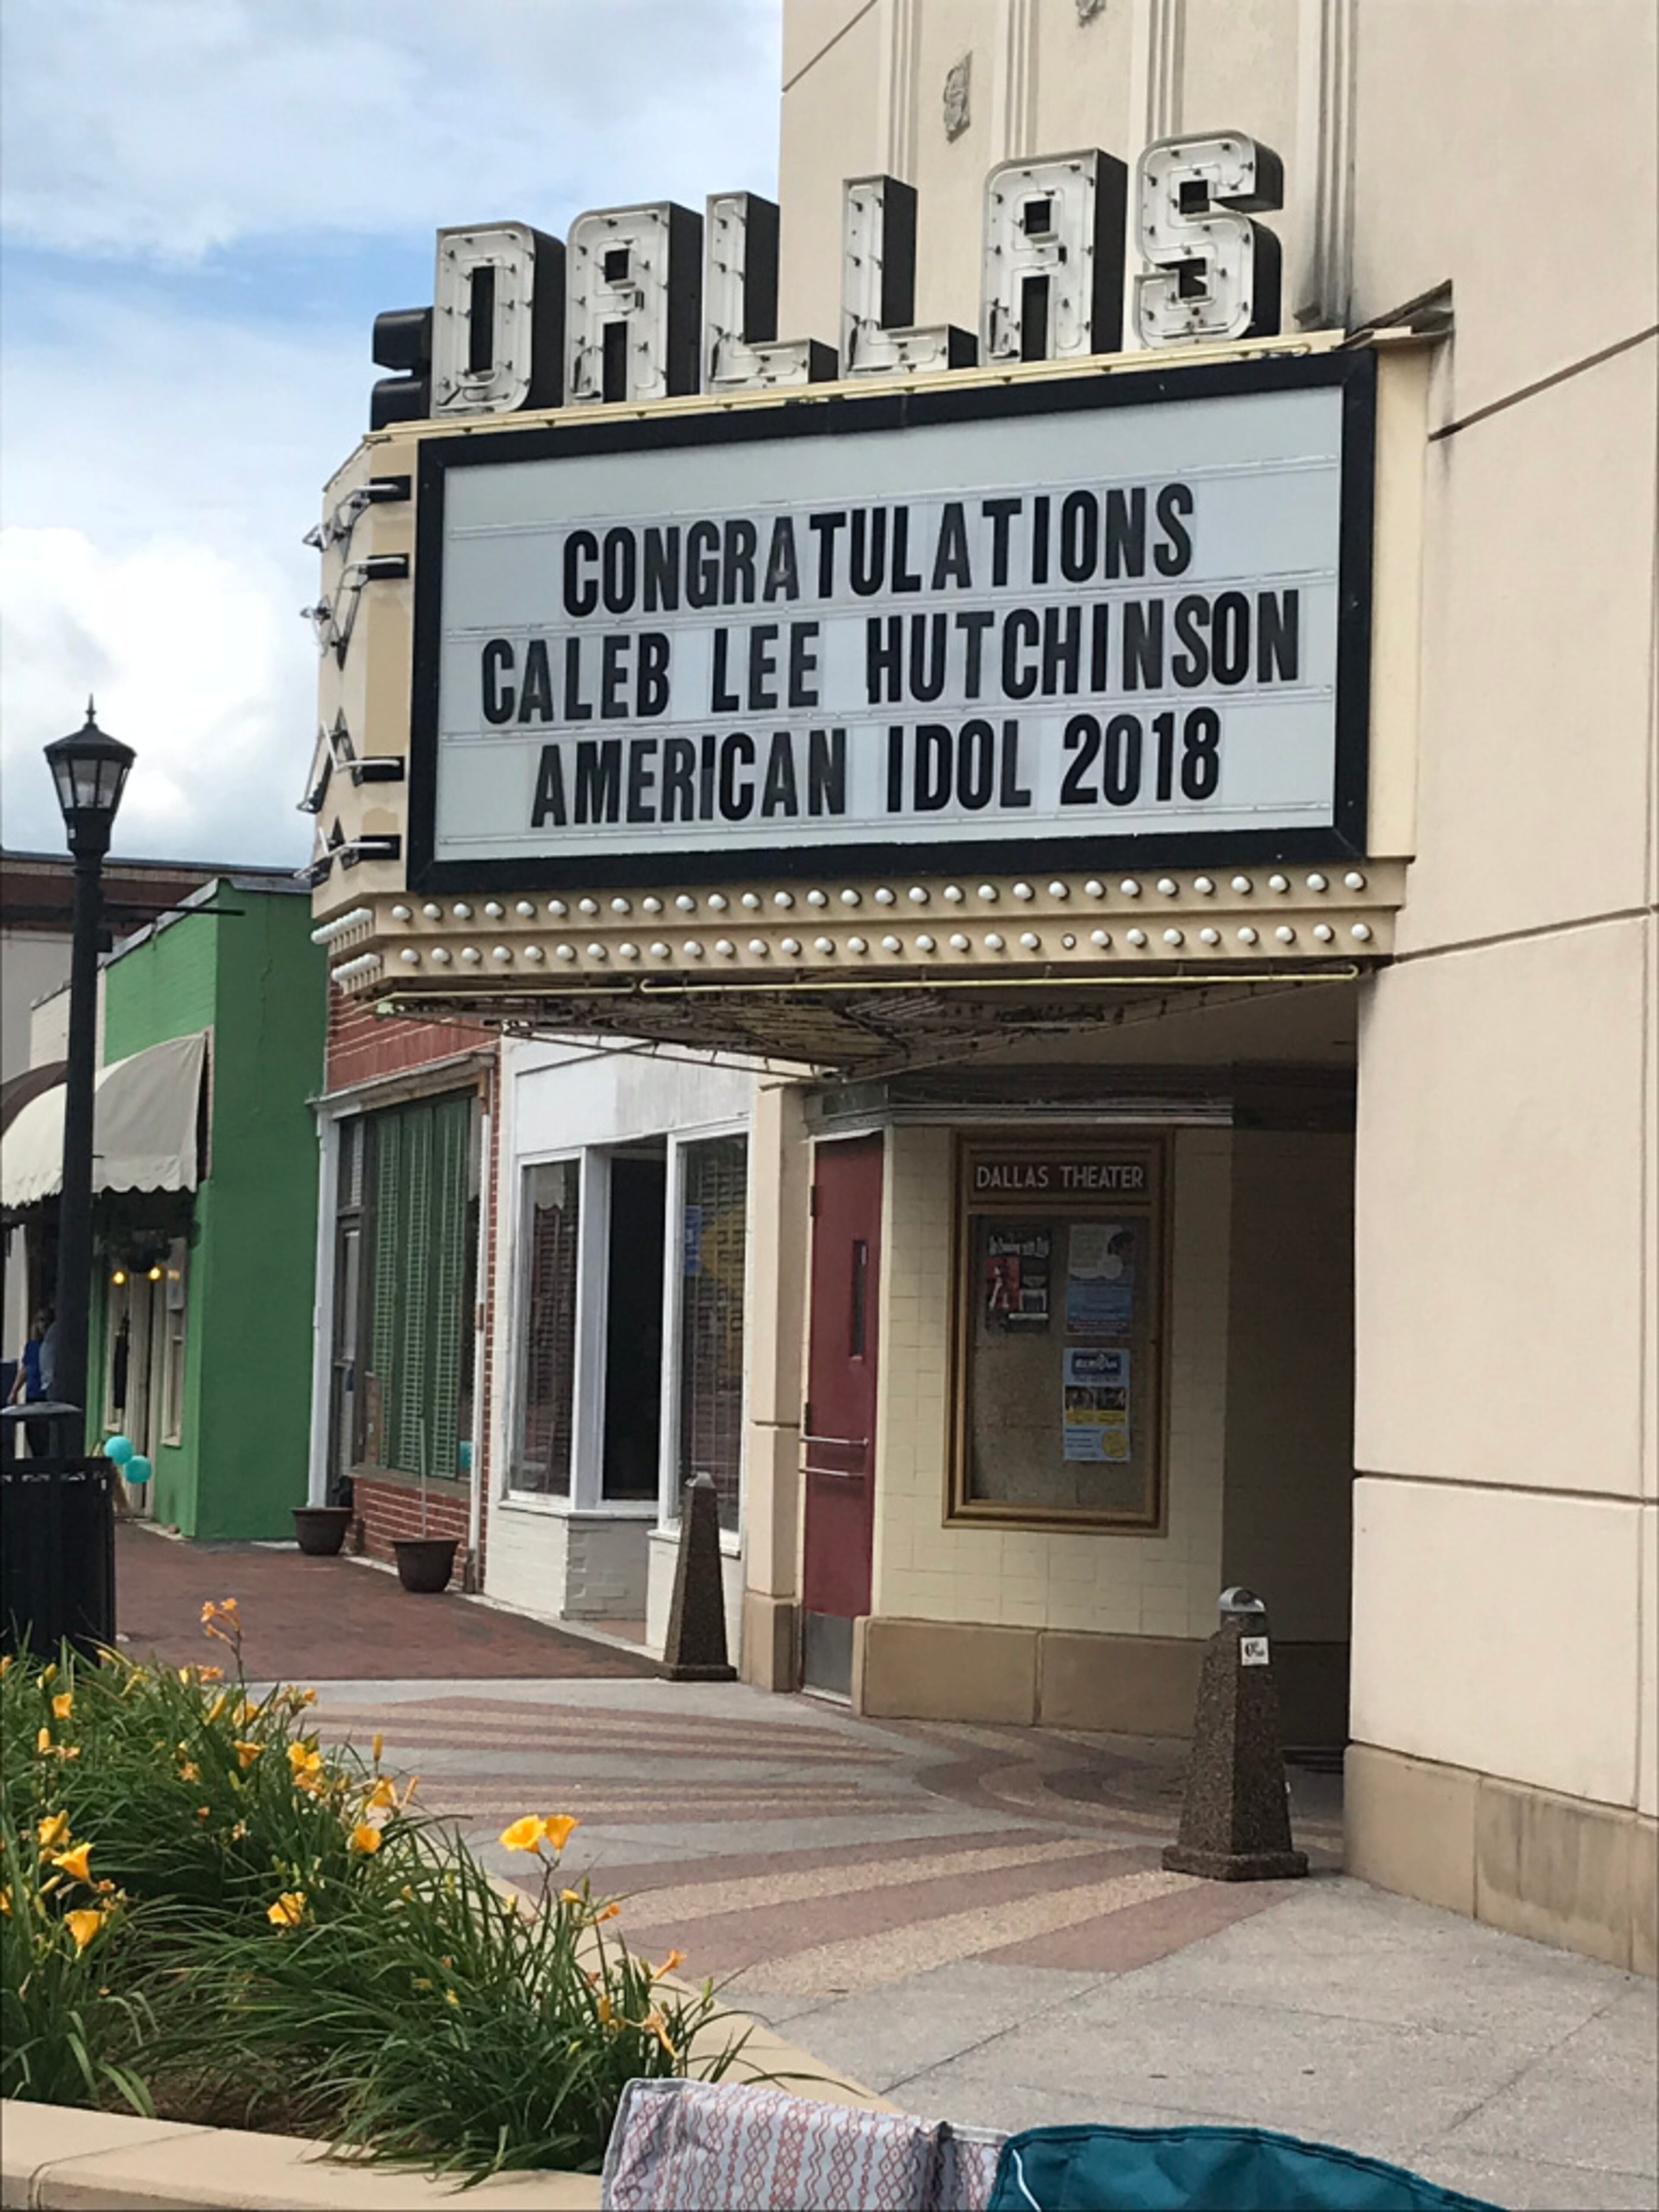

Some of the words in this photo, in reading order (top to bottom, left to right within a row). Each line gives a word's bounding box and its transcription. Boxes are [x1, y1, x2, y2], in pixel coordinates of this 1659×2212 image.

[434, 129, 1284, 414] DALLAS
[563, 482, 1194, 618] CONGRATULATIONS
[481, 631, 671, 725] CALEB
[710, 620, 820, 714] LEE
[866, 588, 1299, 705] HUTCHINSON
[530, 727, 847, 829] AMERICAN
[886, 718, 1032, 814] IDOL
[1059, 706, 1221, 807] 2018
[976, 1165, 1049, 1188] DALLAS
[1059, 1165, 1144, 1188] THEATER
